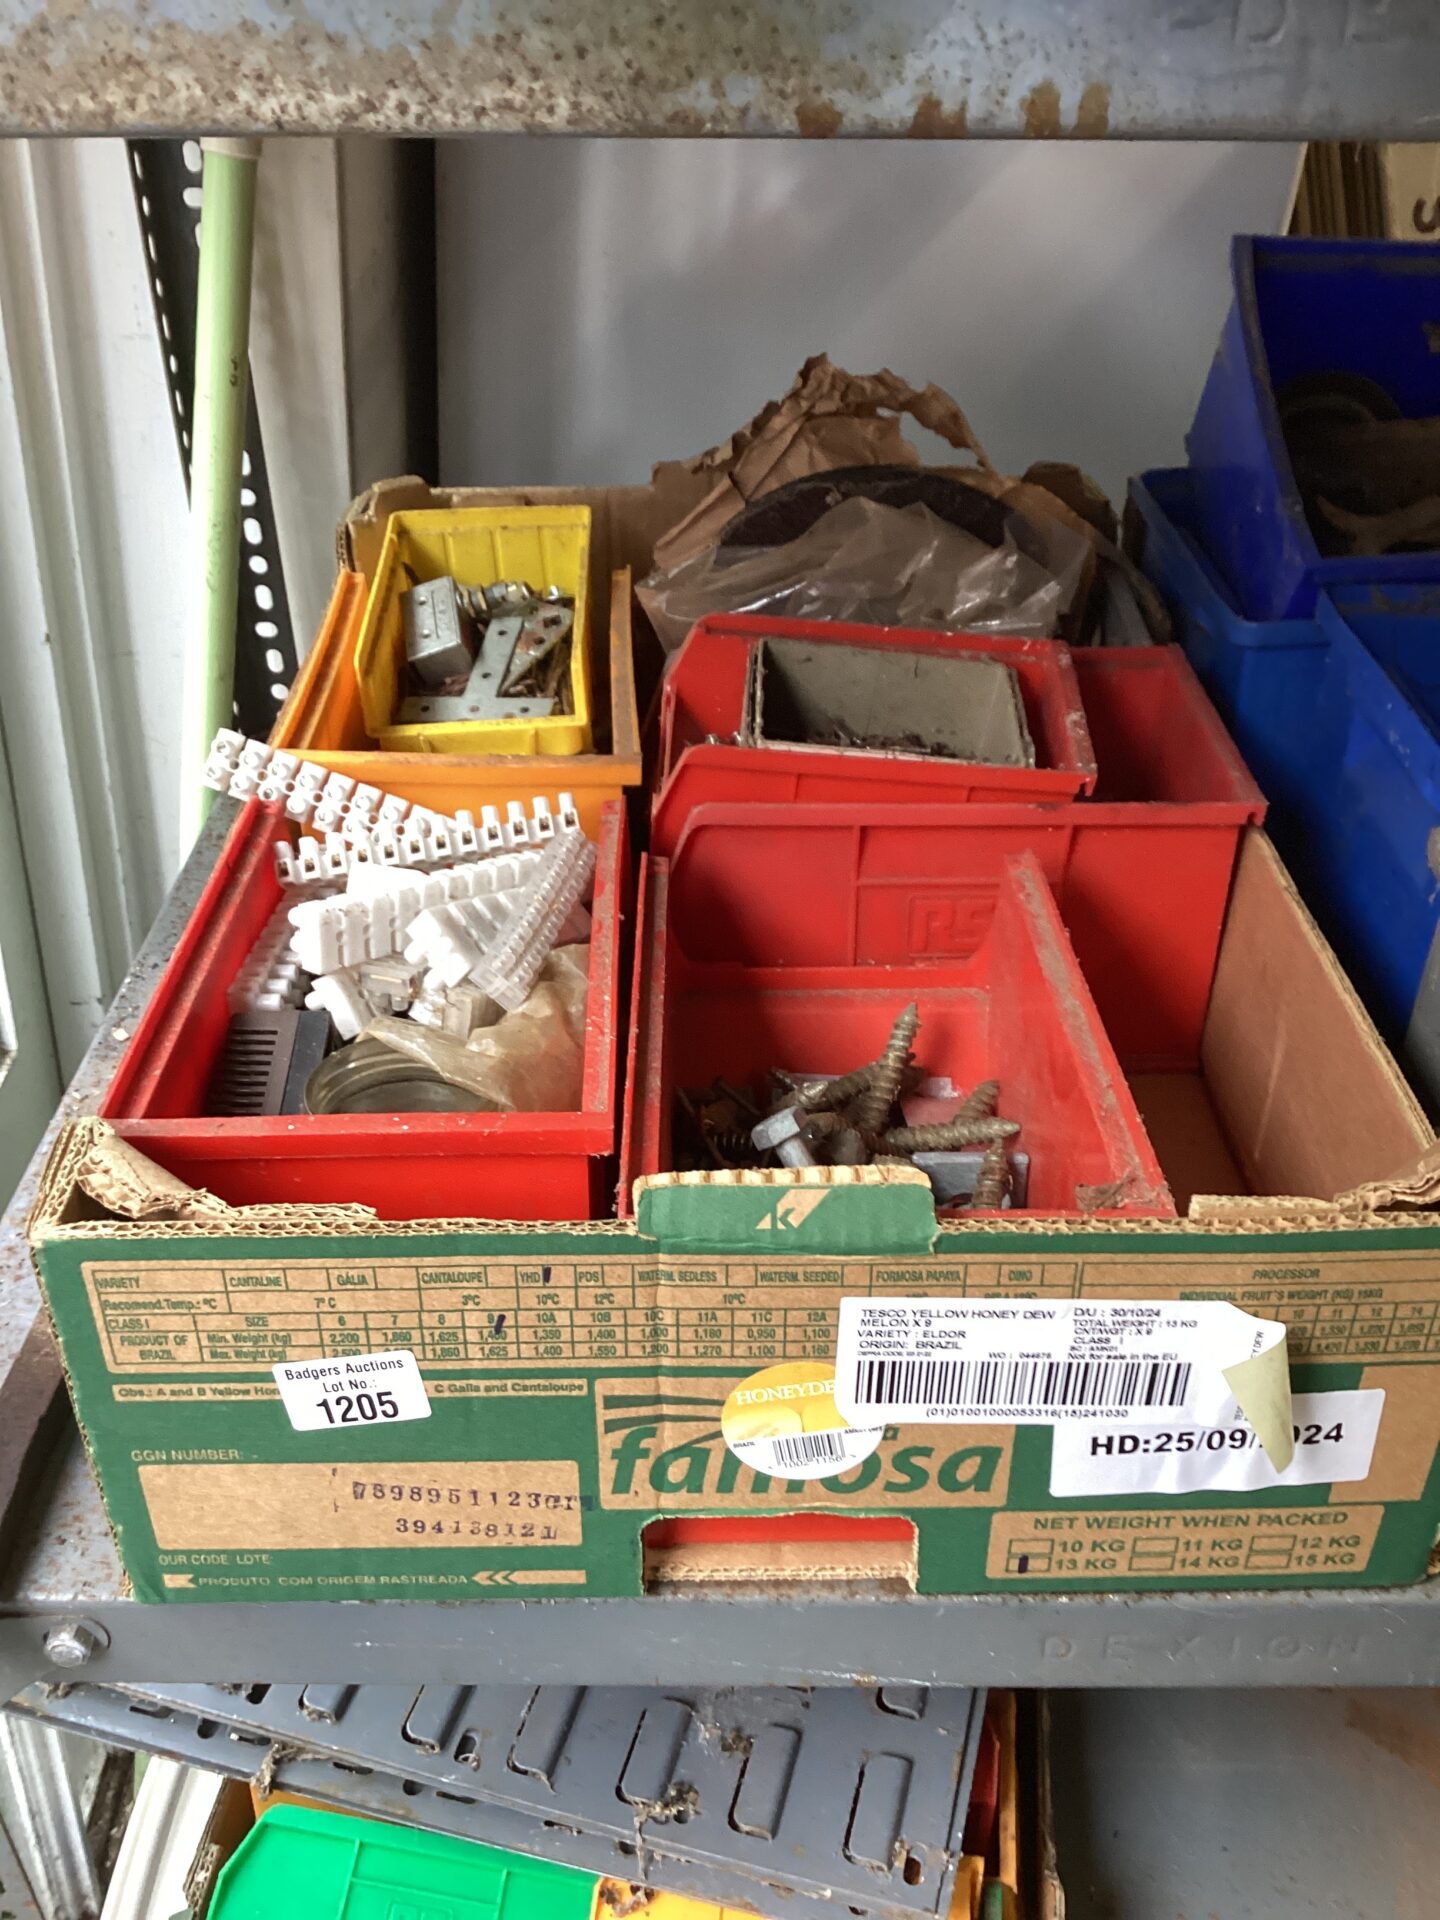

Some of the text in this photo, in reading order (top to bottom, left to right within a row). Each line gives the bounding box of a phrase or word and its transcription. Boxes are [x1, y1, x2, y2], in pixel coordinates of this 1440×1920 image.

[421, 1271, 483, 1284] CANTALOUPE
[519, 1272, 541, 1284] YHD
[578, 1271, 599, 1283] PDS
[803, 1270, 841, 1282] SEEDED
[876, 1270, 962, 1282] FORMOSA PAPAYA
[1252, 1269, 1321, 1280] PROCESSOR
[98, 1277, 140, 1289] VARIETY
[230, 1276, 281, 1287] CANTALINE
[391, 1314, 399, 1325] 7
[438, 1313, 446, 1325] 8
[535, 1312, 558, 1323] 10A
[644, 1310, 664, 1322] 10C
[698, 1311, 718, 1322] 11A
[751, 1311, 773, 1323] 11C
[862, 1308, 1057, 1320] TESCO YELLOW HONEY DEW
[109, 1319, 145, 1330] CLASS
[245, 1316, 269, 1327] SIZE
[338, 1315, 346, 1326] 6
[860, 1318, 910, 1328] MELON
[913, 1318, 922, 1328] X
[1073, 1319, 1109, 1328] TOTAL
[1111, 1319, 1157, 1328] WEIGHT
[1180, 1320, 1198, 1328] KG
[232, 1333, 269, 1346] Weight
[857, 1329, 967, 1339] VARIETY ELDOR
[121, 1335, 188, 1346] PRODUCT OF
[858, 1340, 964, 1350] ORIGIN: BRAZIL
[1073, 1336, 1112, 1345] CLASS
[139, 1350, 176, 1361] BRAZIL
[1068, 1352, 1087, 1361] Not
[1162, 1353, 1179, 1361] EU
[284, 1357, 405, 1382] Badgers Auctions
[118, 1387, 152, 1398] Obs.:
[157, 1387, 167, 1397] A
[170, 1387, 193, 1397] and
[198, 1387, 206, 1397] B
[210, 1386, 251, 1397] Yellow
[322, 1378, 378, 1395] Lot No.:
[434, 1383, 445, 1394] C
[484, 1382, 508, 1394] and
[511, 1382, 585, 1396] Cantaloupe
[735, 1380, 836, 1405] HONEYDE
[316, 1391, 400, 1424] 1205
[131, 1449, 167, 1462] GGN
[1033, 1511, 1348, 1531] NET WEIGHT WHEN PACKED
[1059, 1540, 1126, 1553] 10 KG
[1183, 1538, 1242, 1552] 11 KG
[1300, 1535, 1361, 1549] 12 KG
[159, 1554, 187, 1566] OUR
[191, 1554, 228, 1566] CODE
[1055, 1557, 1117, 1570] 13 KG
[1179, 1554, 1239, 1568] 14 KG
[1323, 1553, 1356, 1566] KG
[198, 1574, 468, 1587] PRODUTO COM ORIGEM RASTREADA
[1041, 1634, 1367, 1662] DEXION
